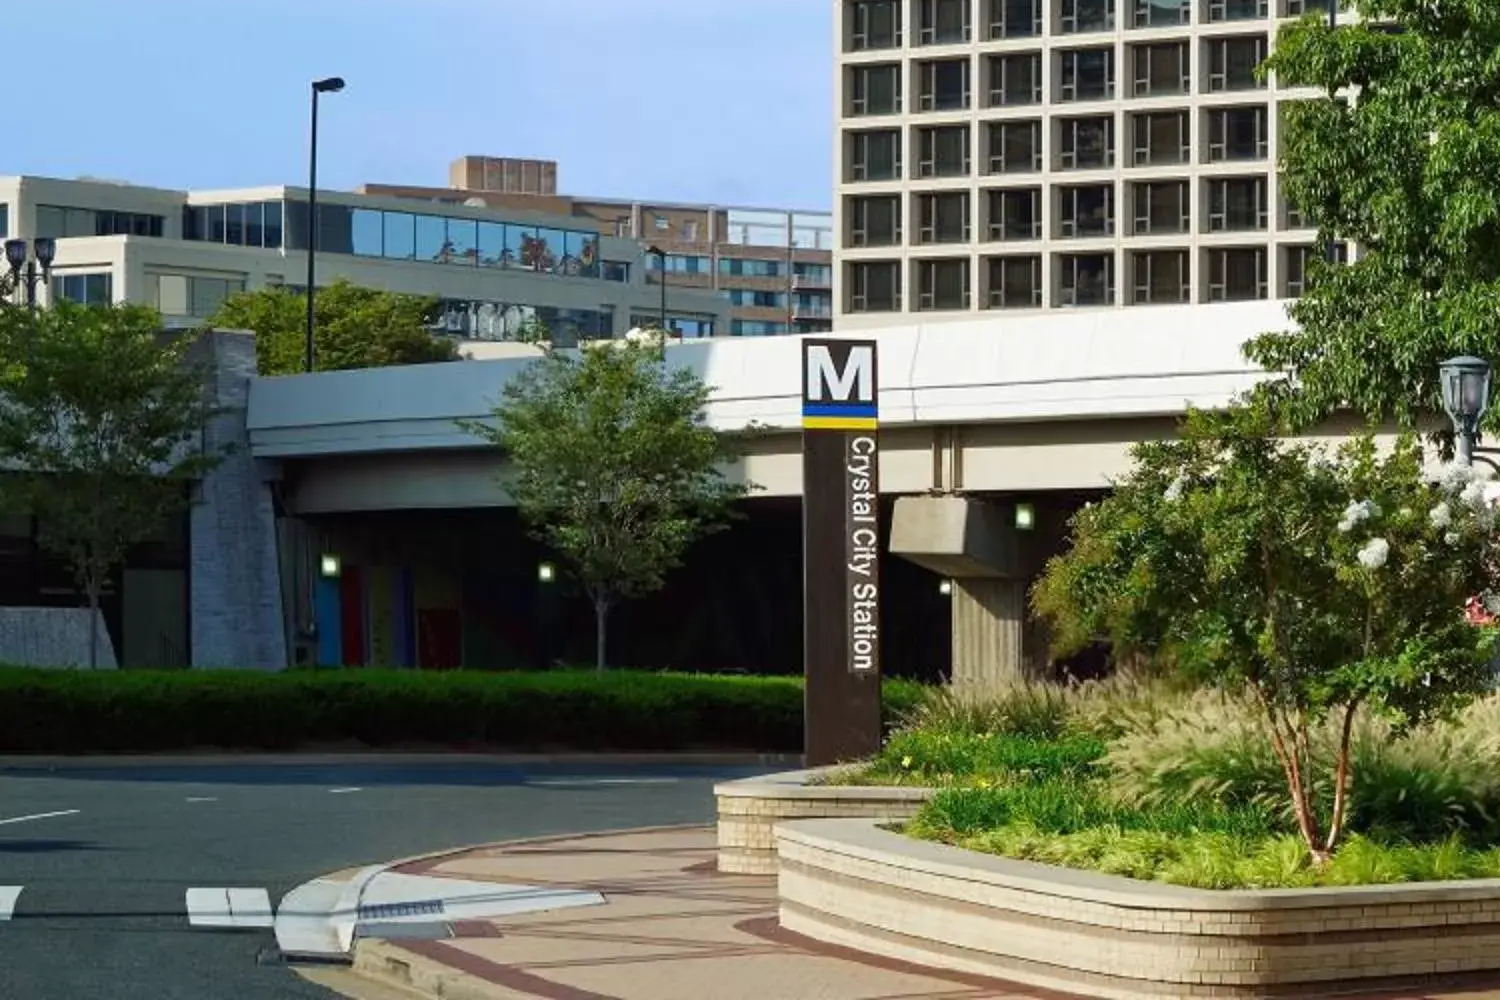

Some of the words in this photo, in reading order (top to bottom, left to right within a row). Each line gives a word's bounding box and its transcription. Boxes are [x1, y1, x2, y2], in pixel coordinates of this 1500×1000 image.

[807, 345, 872, 400] M
[847, 437, 876, 521] Crystal
[848, 529, 877, 576] City
[853, 584, 877, 669] Station
